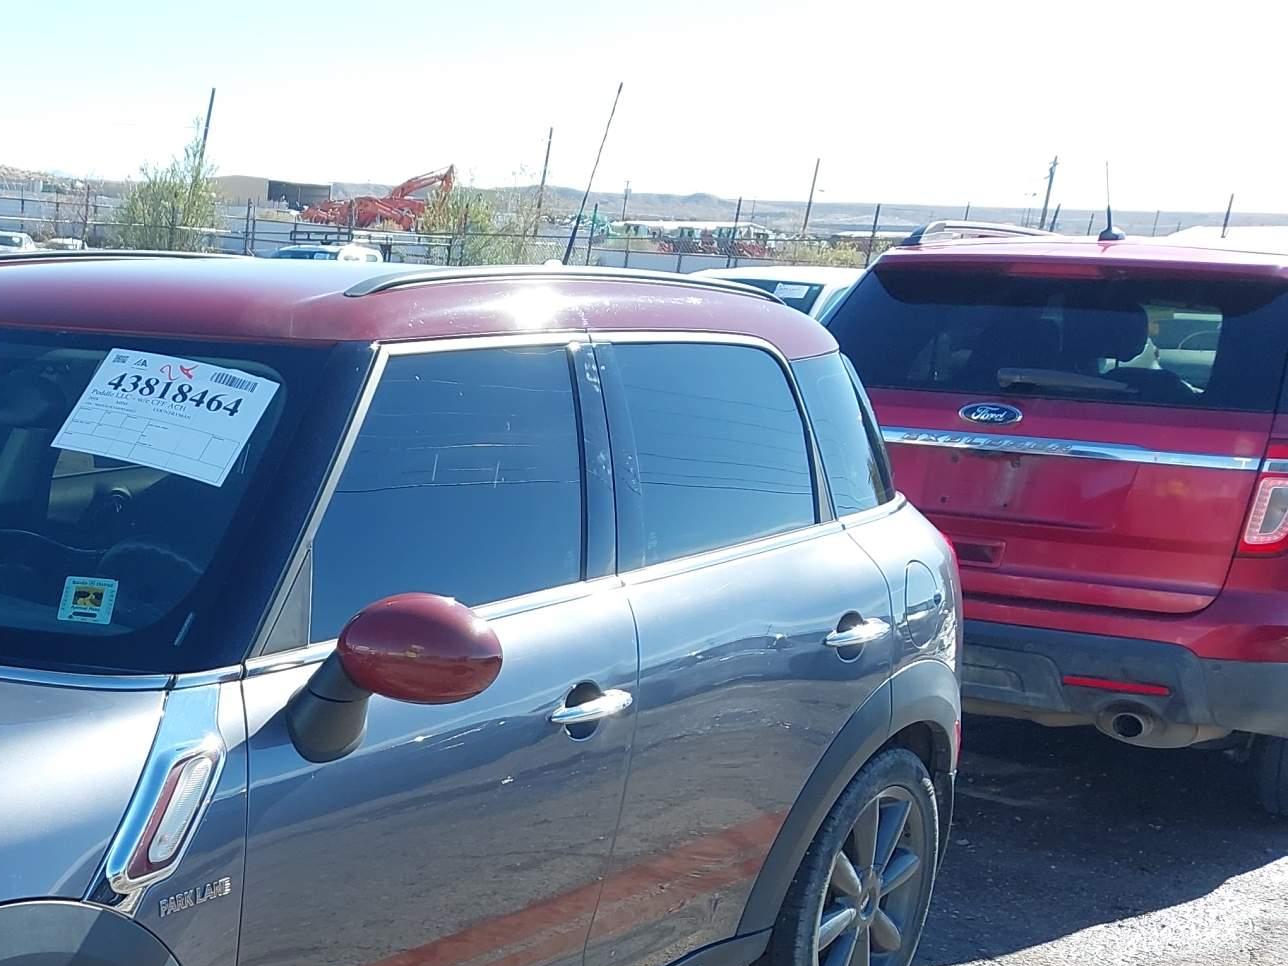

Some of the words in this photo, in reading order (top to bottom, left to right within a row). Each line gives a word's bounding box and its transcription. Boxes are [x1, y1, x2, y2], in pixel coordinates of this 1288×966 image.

[107, 372, 244, 417] 43818464
[115, 391, 132, 400] LLC
[971, 406, 1007, 423] Ford
[159, 888, 195, 918] PARK
[196, 876, 232, 905] LANE
